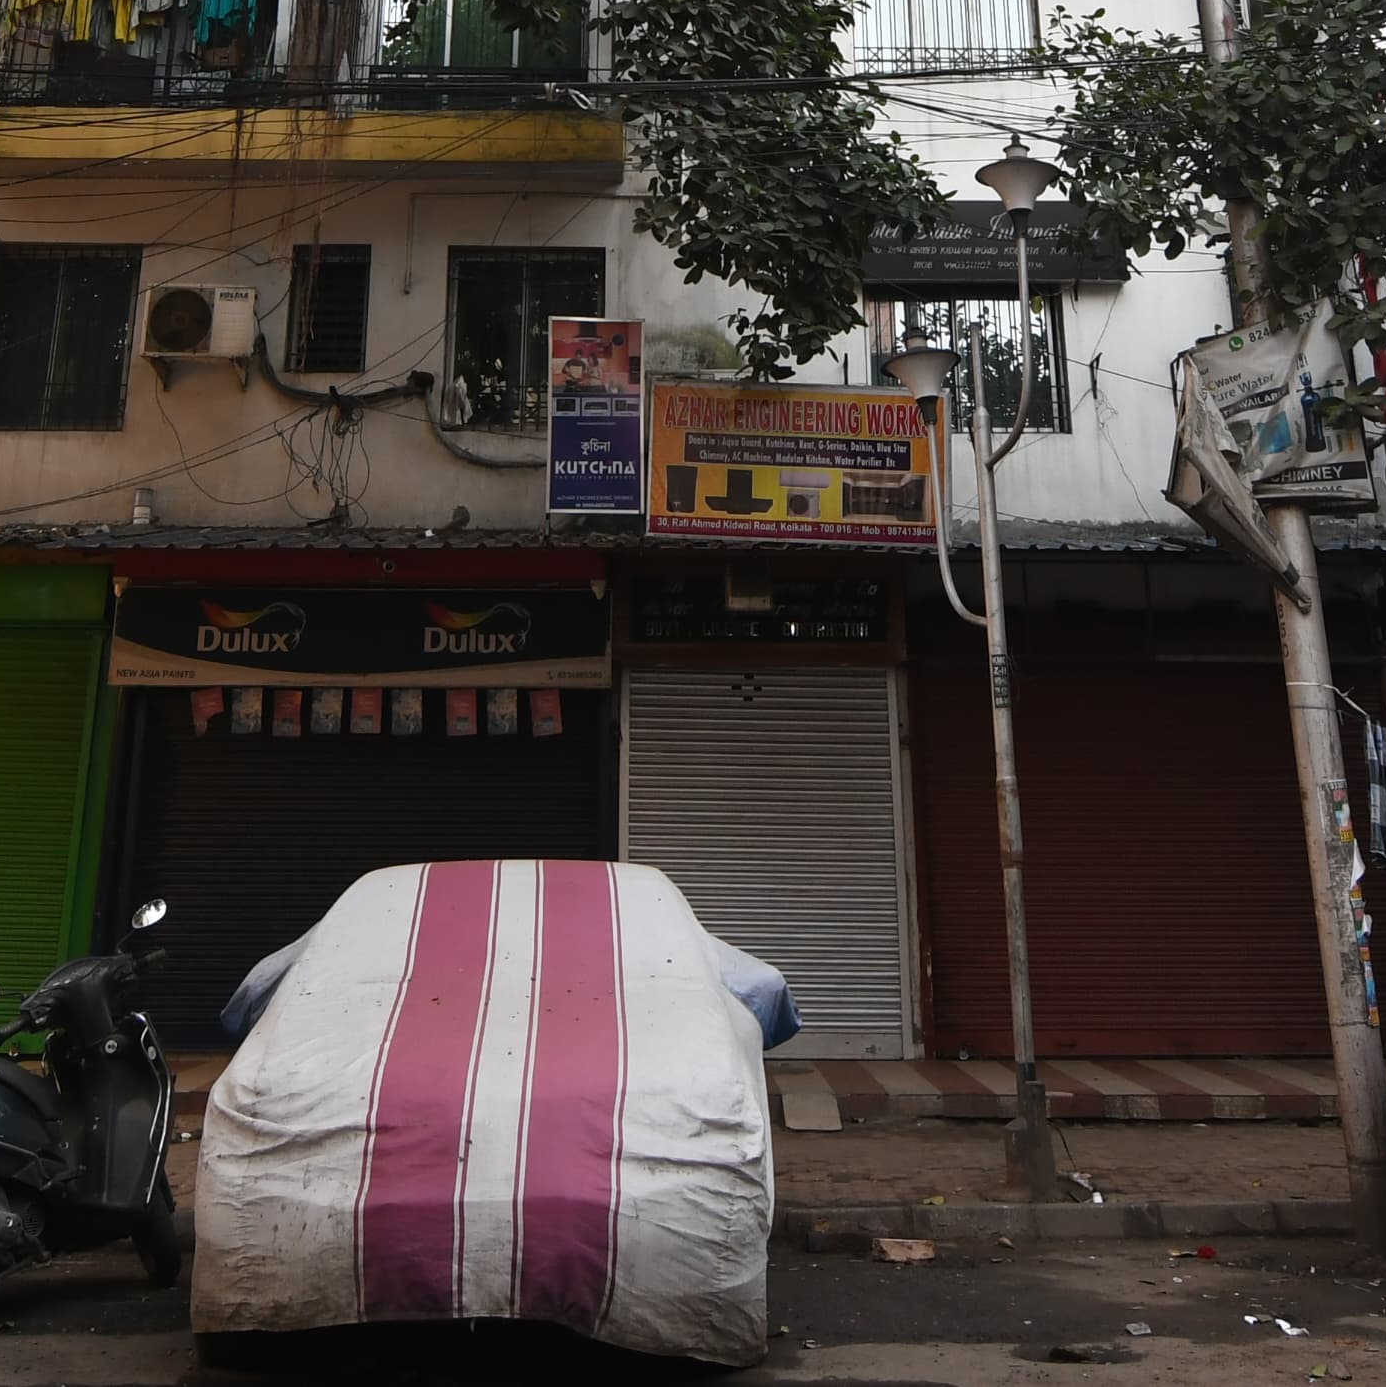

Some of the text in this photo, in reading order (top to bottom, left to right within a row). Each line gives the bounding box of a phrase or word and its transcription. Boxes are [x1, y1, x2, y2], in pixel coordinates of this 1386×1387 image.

[868, 218, 901, 239] otel
[1237, 373, 1276, 395] Water
[663, 395, 728, 429] AZHAR
[733, 398, 861, 434] ENGINEERING
[581, 438, 611, 455] কুচিনা
[688, 435, 707, 445] Deals
[722, 437, 739, 448] Aqua
[741, 438, 764, 449] Guard,
[818, 441, 849, 452] G-Series,
[850, 442, 875, 453] Daikin,
[877, 442, 892, 453] Blue
[893, 443, 907, 453] Star
[699, 450, 731, 462] Chimney,
[732, 451, 741, 461] AC
[743, 452, 773, 463] Machine,
[775, 453, 804, 464] Modular
[835, 455, 854, 465] Water
[857, 456, 884, 466] Purifier
[657, 518, 670, 527] 30,
[672, 518, 689, 527] Rafi
[691, 519, 721, 528] Ahmed
[723, 520, 751, 530] Kidwai
[754, 522, 778, 532] Road,
[781, 522, 812, 532] Kolkata
[820, 524, 834, 533] 700
[836, 525, 852, 534] 016
[862, 526, 880, 535] Mob
[196, 625, 291, 653] Dulux
[423, 627, 517, 654] Dulux
[116, 669, 196, 679] NEW ASIA PAINTS
